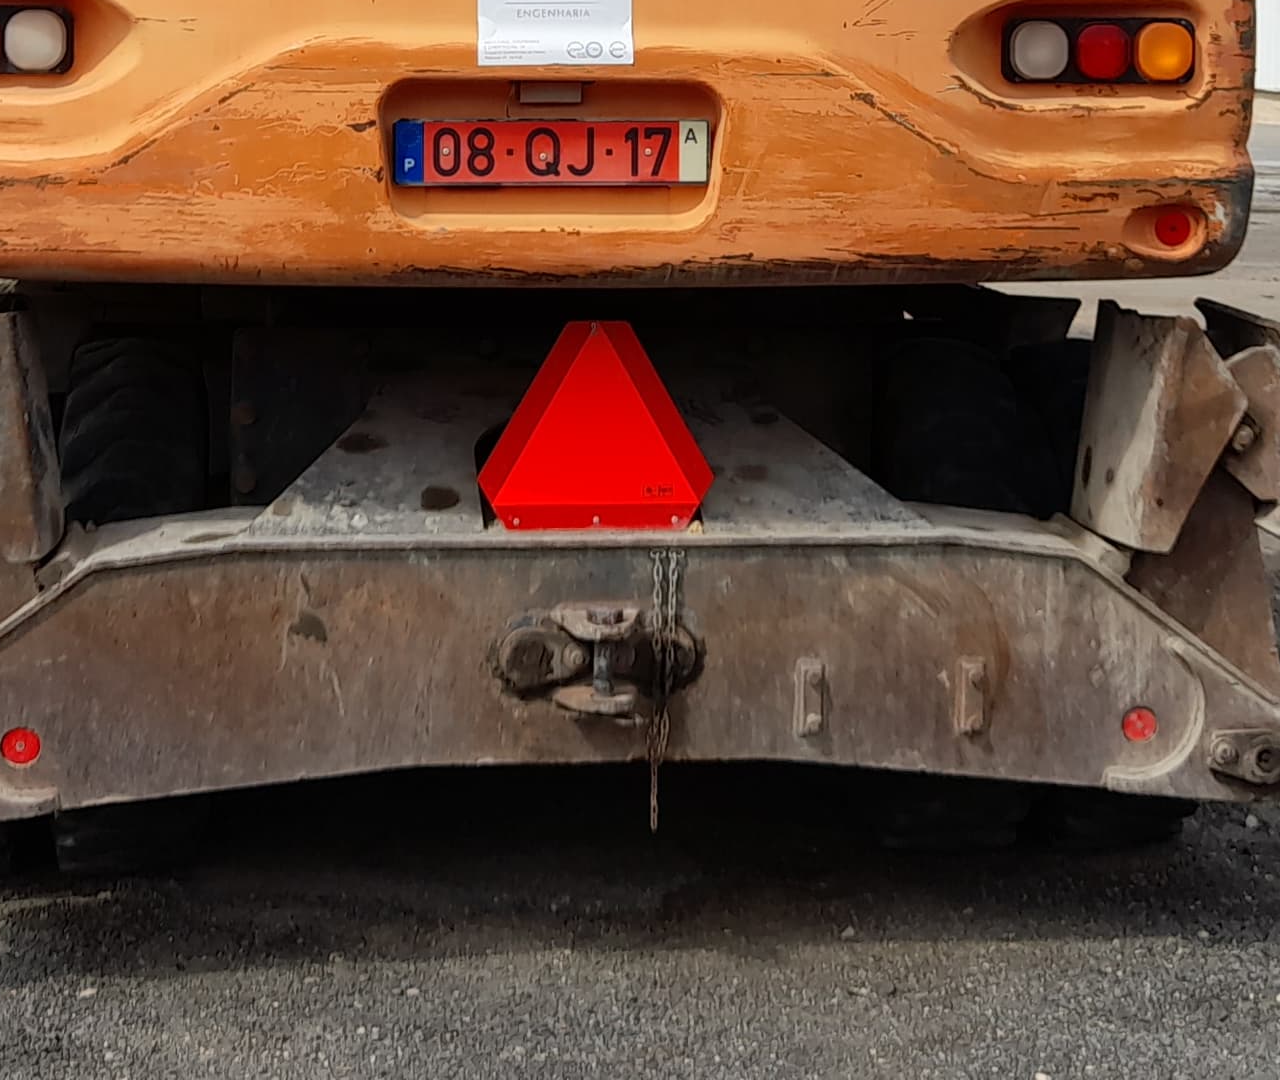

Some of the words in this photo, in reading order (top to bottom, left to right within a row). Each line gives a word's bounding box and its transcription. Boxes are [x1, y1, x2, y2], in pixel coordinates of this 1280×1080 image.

[516, 8, 591, 19] ENGENHARIA
[403, 158, 415, 172] P
[684, 128, 698, 144] A
